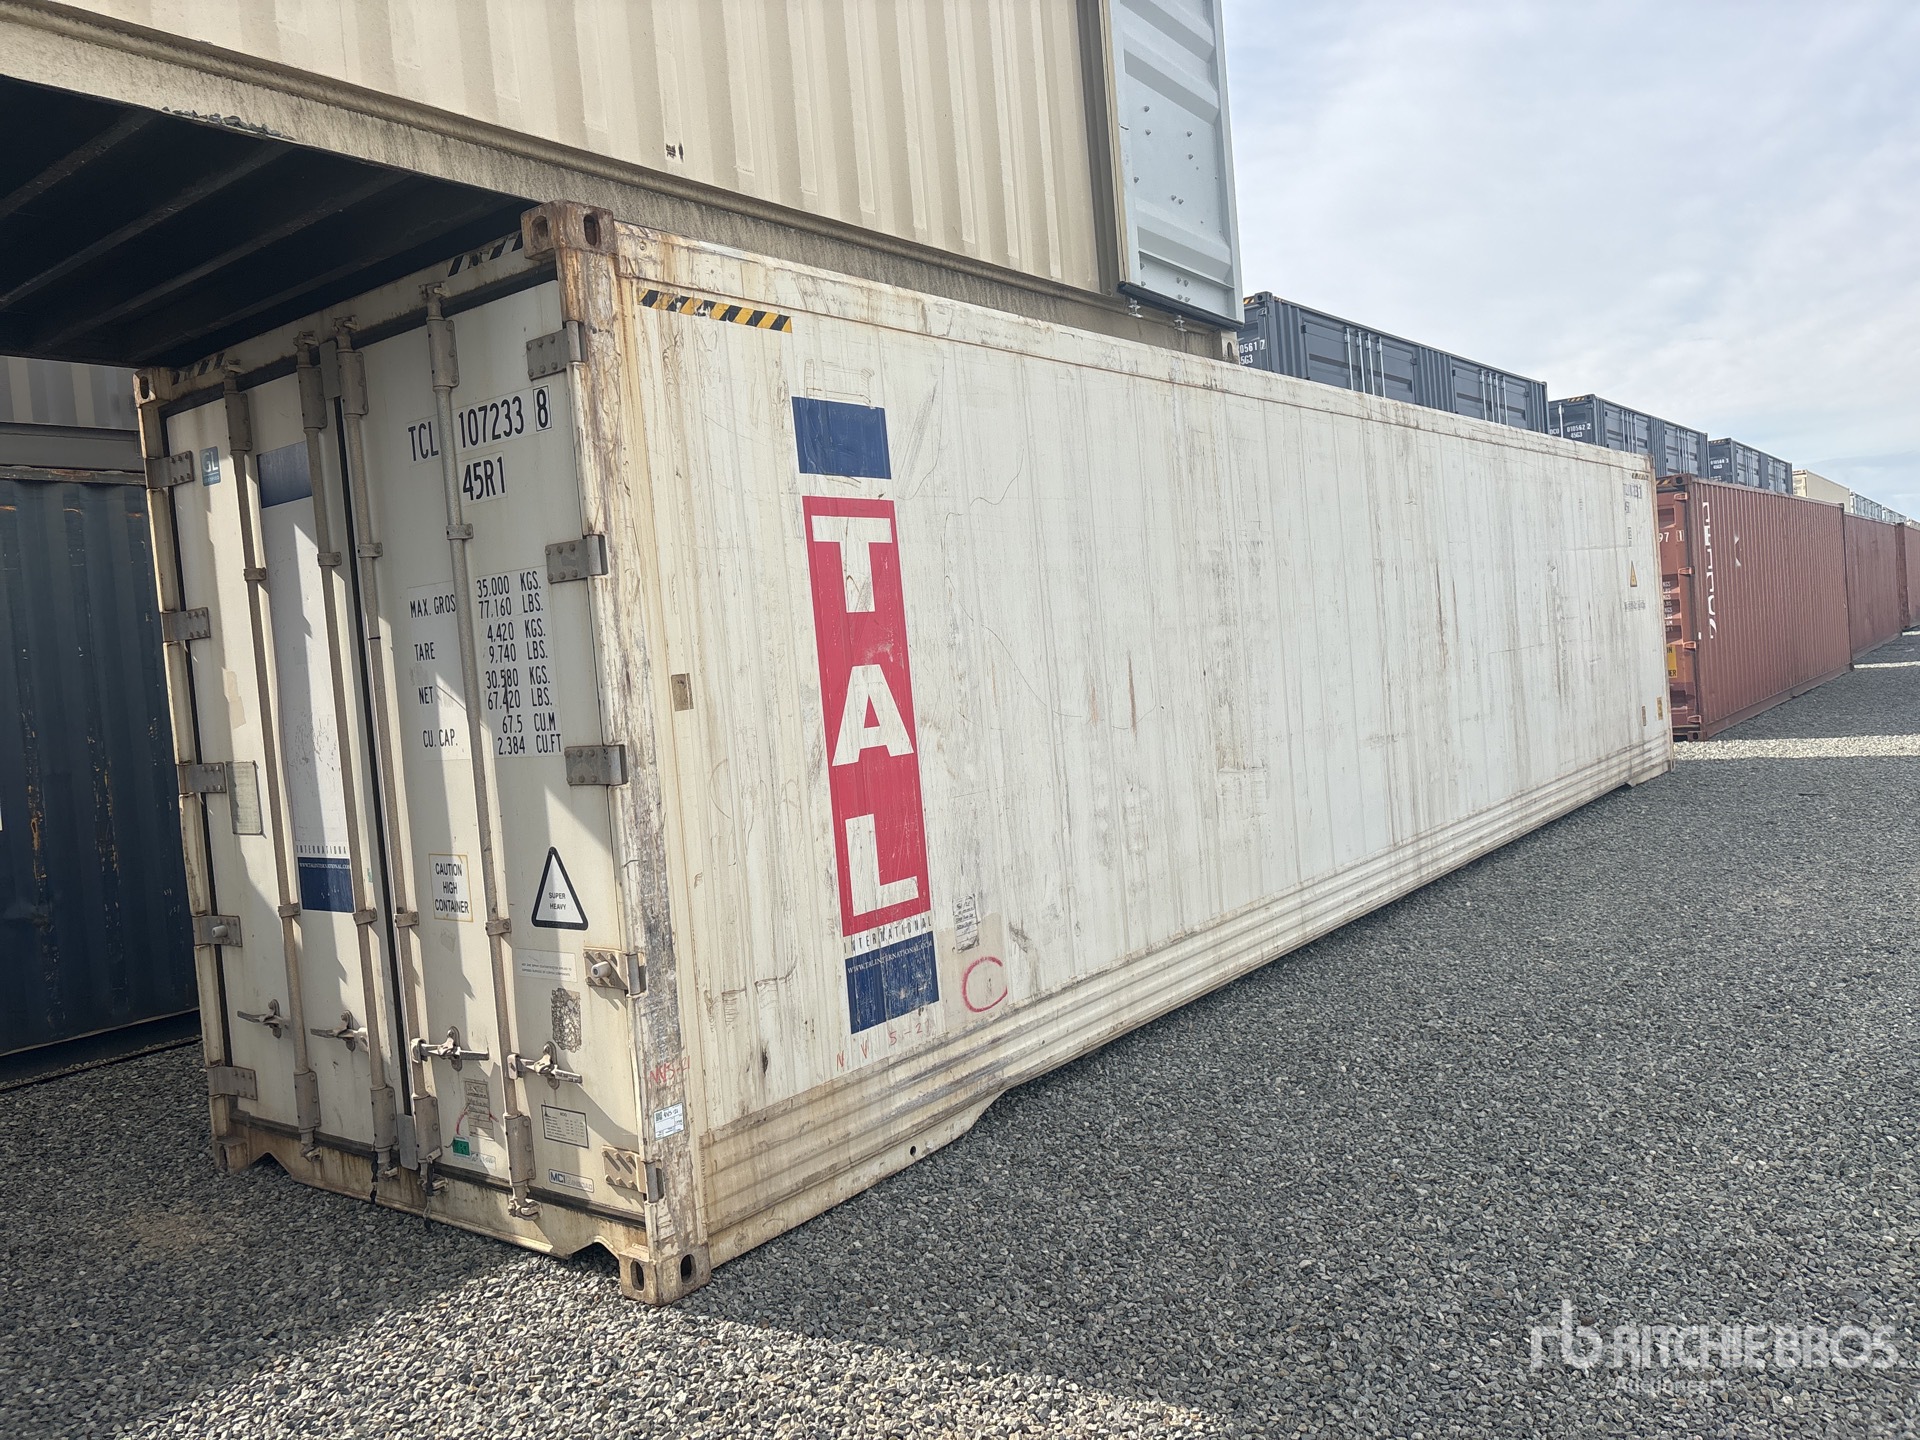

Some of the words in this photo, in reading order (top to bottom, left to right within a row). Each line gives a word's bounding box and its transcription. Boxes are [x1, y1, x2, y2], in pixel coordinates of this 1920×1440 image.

[408, 421, 439, 462] TCL
[458, 396, 525, 449] 107233
[536, 388, 549, 429] 8
[462, 456, 506, 501] 45R1
[519, 570, 542, 592] KGS.
[409, 597, 432, 619] MAX.
[433, 594, 457, 615] GROS
[521, 592, 544, 614] LBS.
[524, 617, 546, 639] KGS.
[414, 641, 436, 662] TARE
[526, 639, 549, 661] LBS.
[528, 664, 551, 686] KGS.
[418, 685, 434, 705] NET
[530, 686, 553, 708] LBS.
[533, 711, 557, 732] CU.M
[811, 515, 919, 917] TAL
[422, 729, 437, 749] CU.
[438, 728, 459, 748] CAP.
[296, 844, 348, 855] INTERNATIONA
[435, 862, 463, 877] CAUTION
[442, 881, 459, 895] HIGH
[548, 892, 566, 900] SUPER
[434, 898, 470, 914] CONTAINER
[549, 902, 567, 911] HEAVY
[843, 916, 933, 954] INTERNATIONAL
